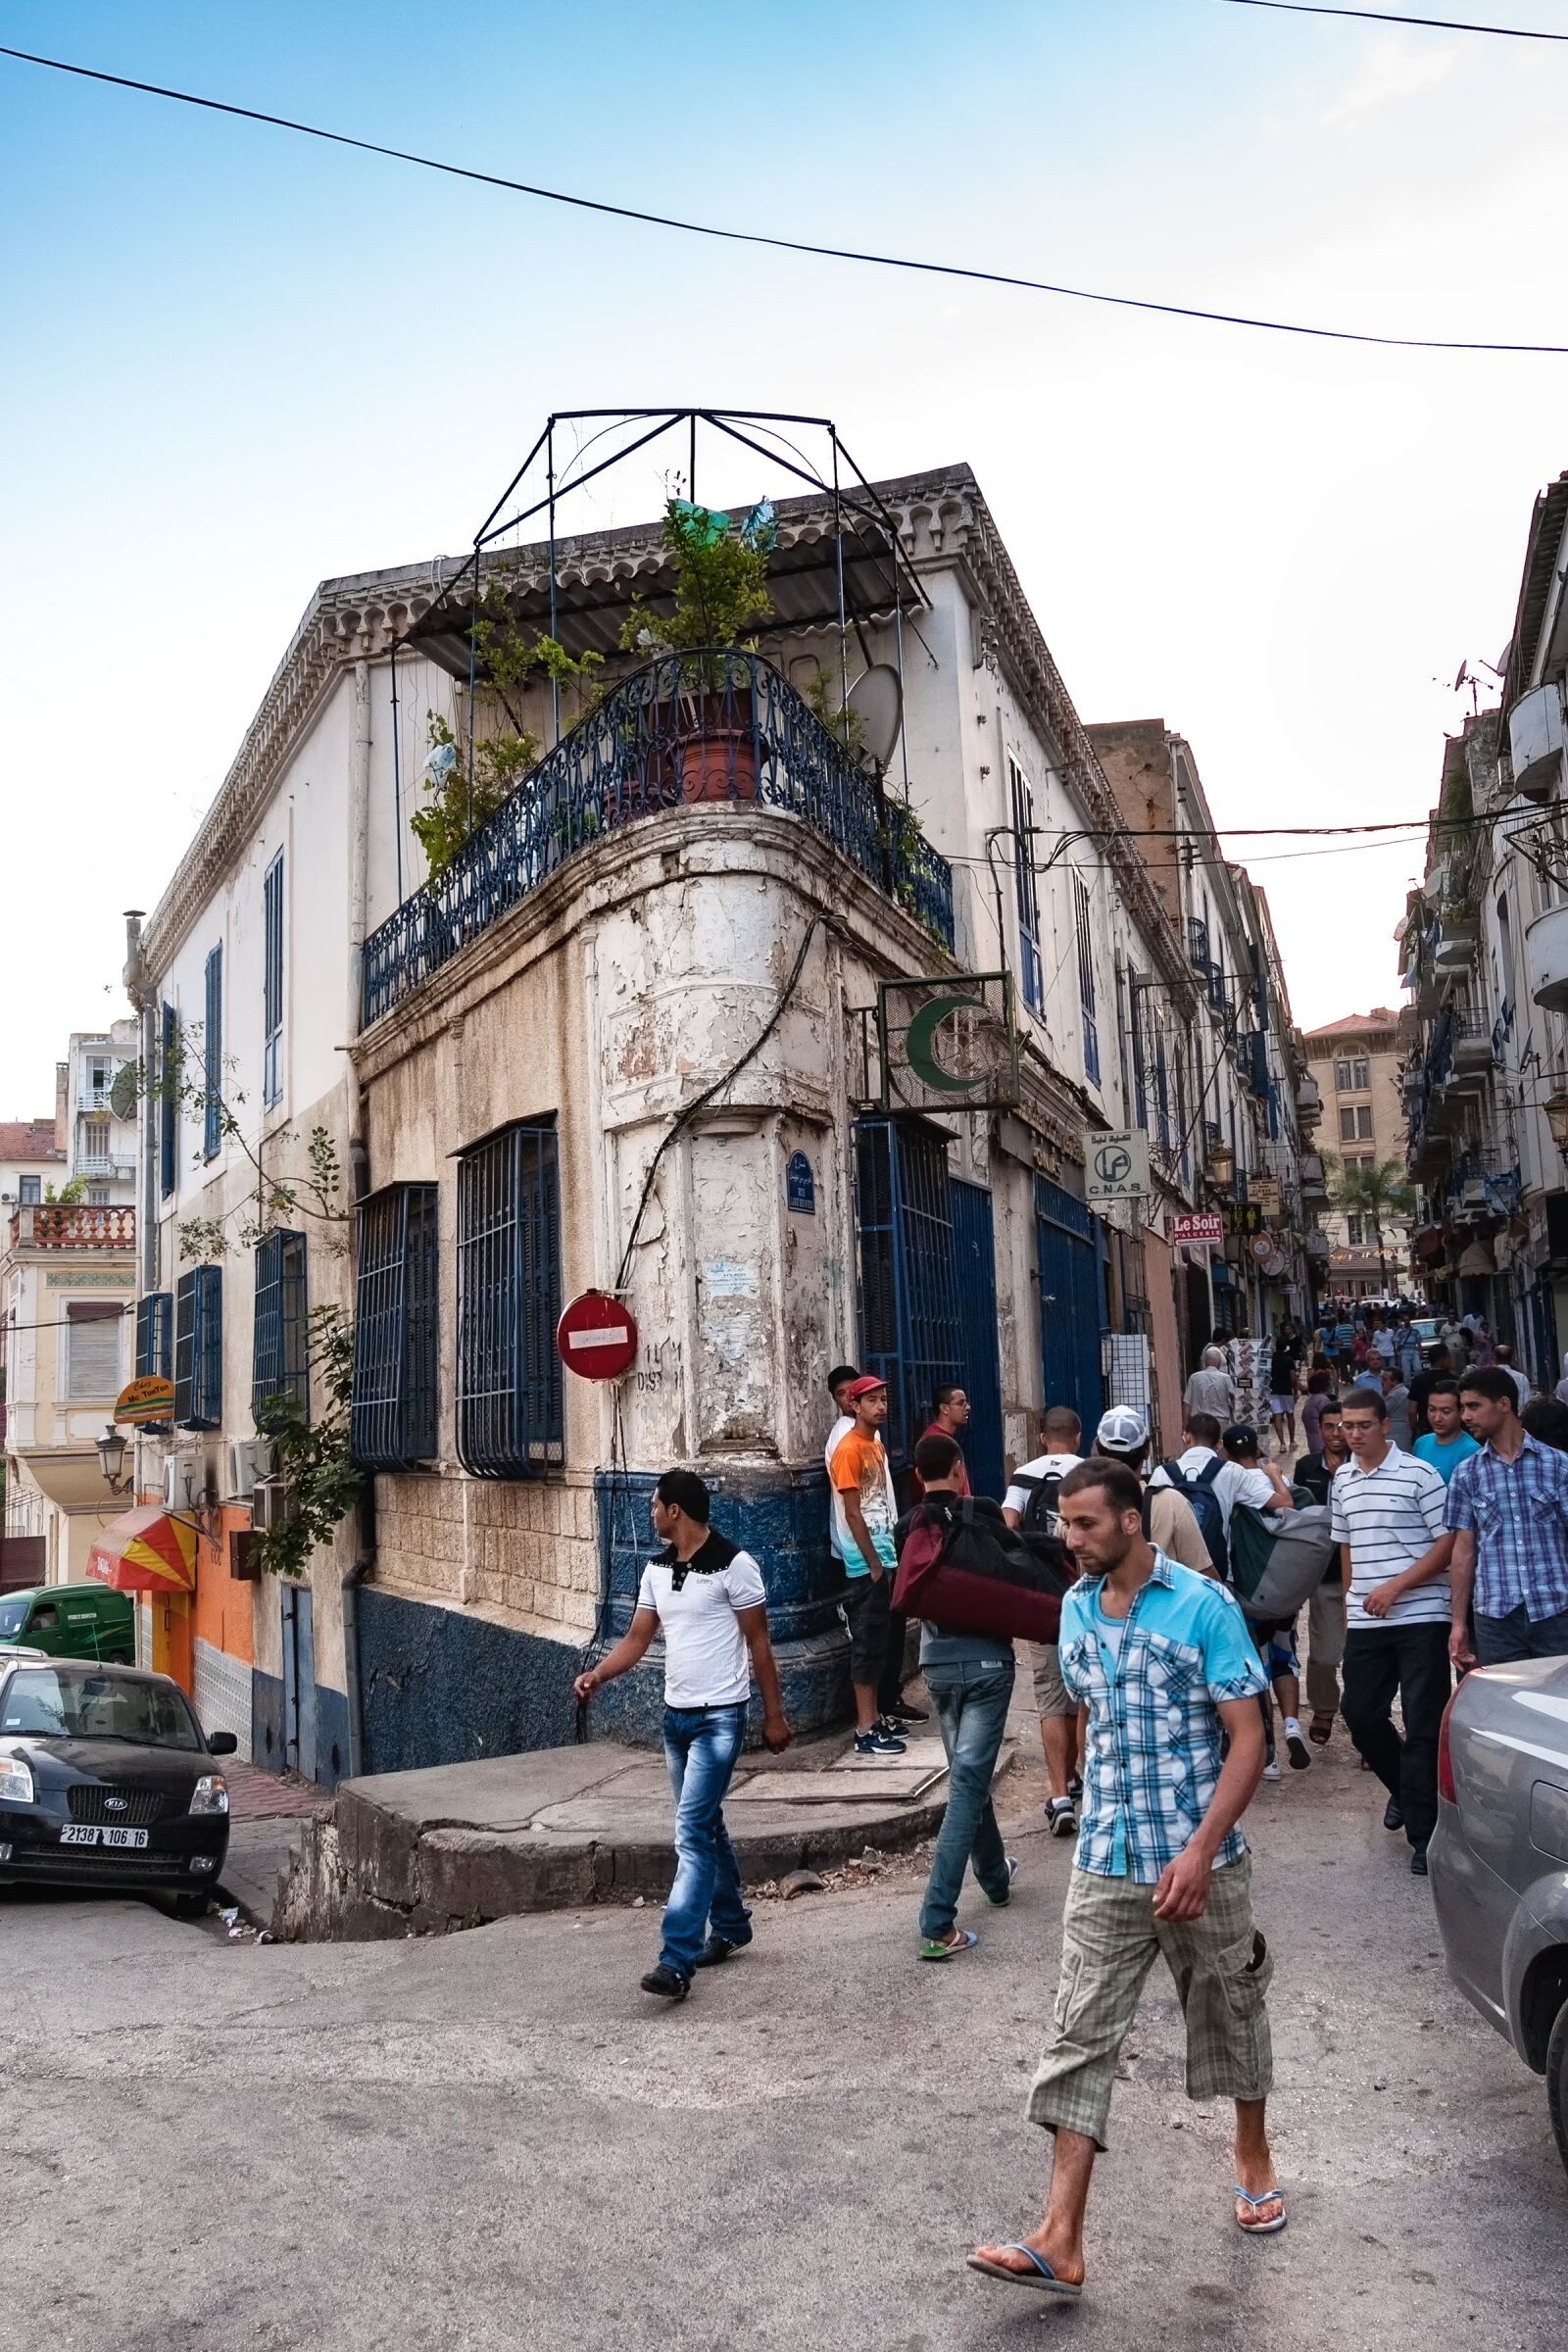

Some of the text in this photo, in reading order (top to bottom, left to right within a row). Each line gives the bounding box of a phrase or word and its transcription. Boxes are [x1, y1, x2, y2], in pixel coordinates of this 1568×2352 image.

[1174, 1214, 1220, 1232] Le Soir
[127, 1384, 170, 1403] Mc TonTon
[108, 1799, 123, 1808] KIA
[109, 1829, 128, 1845] 106
[134, 1831, 146, 1846] 16
